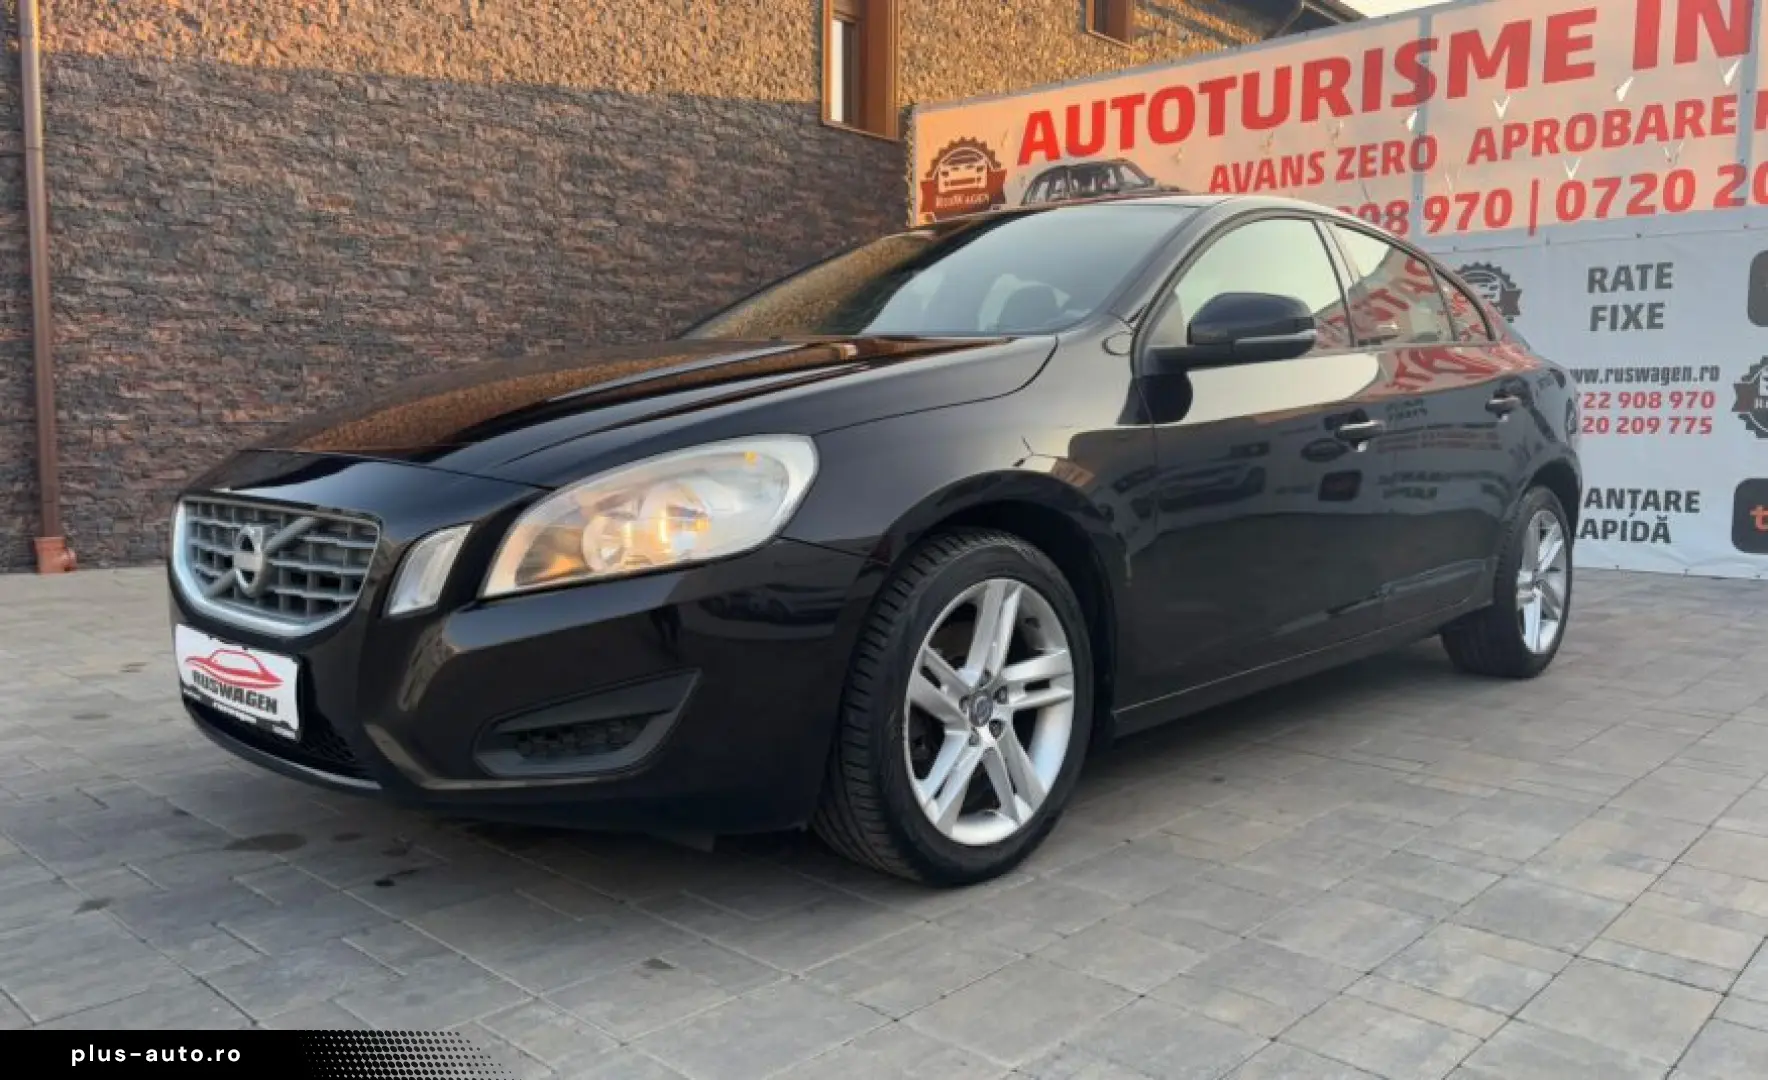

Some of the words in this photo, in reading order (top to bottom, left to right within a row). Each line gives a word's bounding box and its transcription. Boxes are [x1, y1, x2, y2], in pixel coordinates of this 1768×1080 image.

[1016, 8, 1599, 167] AUTOTURISME
[1633, 0, 1749, 70] IN
[1208, 150, 1327, 195] AVANS
[1335, 136, 1438, 183] ZERO
[1467, 95, 1738, 165] APROBARE
[1425, 188, 1514, 235] 970
[1556, 168, 1697, 222] 0720
[1587, 262, 1673, 293] RATE
[1590, 303, 1665, 331] FIXE
[1569, 365, 1720, 386] ww.ruswagen.ro
[1577, 391, 1612, 409] 22
[1618, 391, 1661, 409] 908
[1669, 391, 1715, 409] 970
[1580, 416, 1610, 434] 20
[1616, 416, 1660, 434] 209
[1668, 416, 1713, 434] 775
[1583, 488, 1701, 517] ANȚARE
[1575, 515, 1671, 543] APIDĂ
[192, 669, 278, 715] RUSWAGEN
